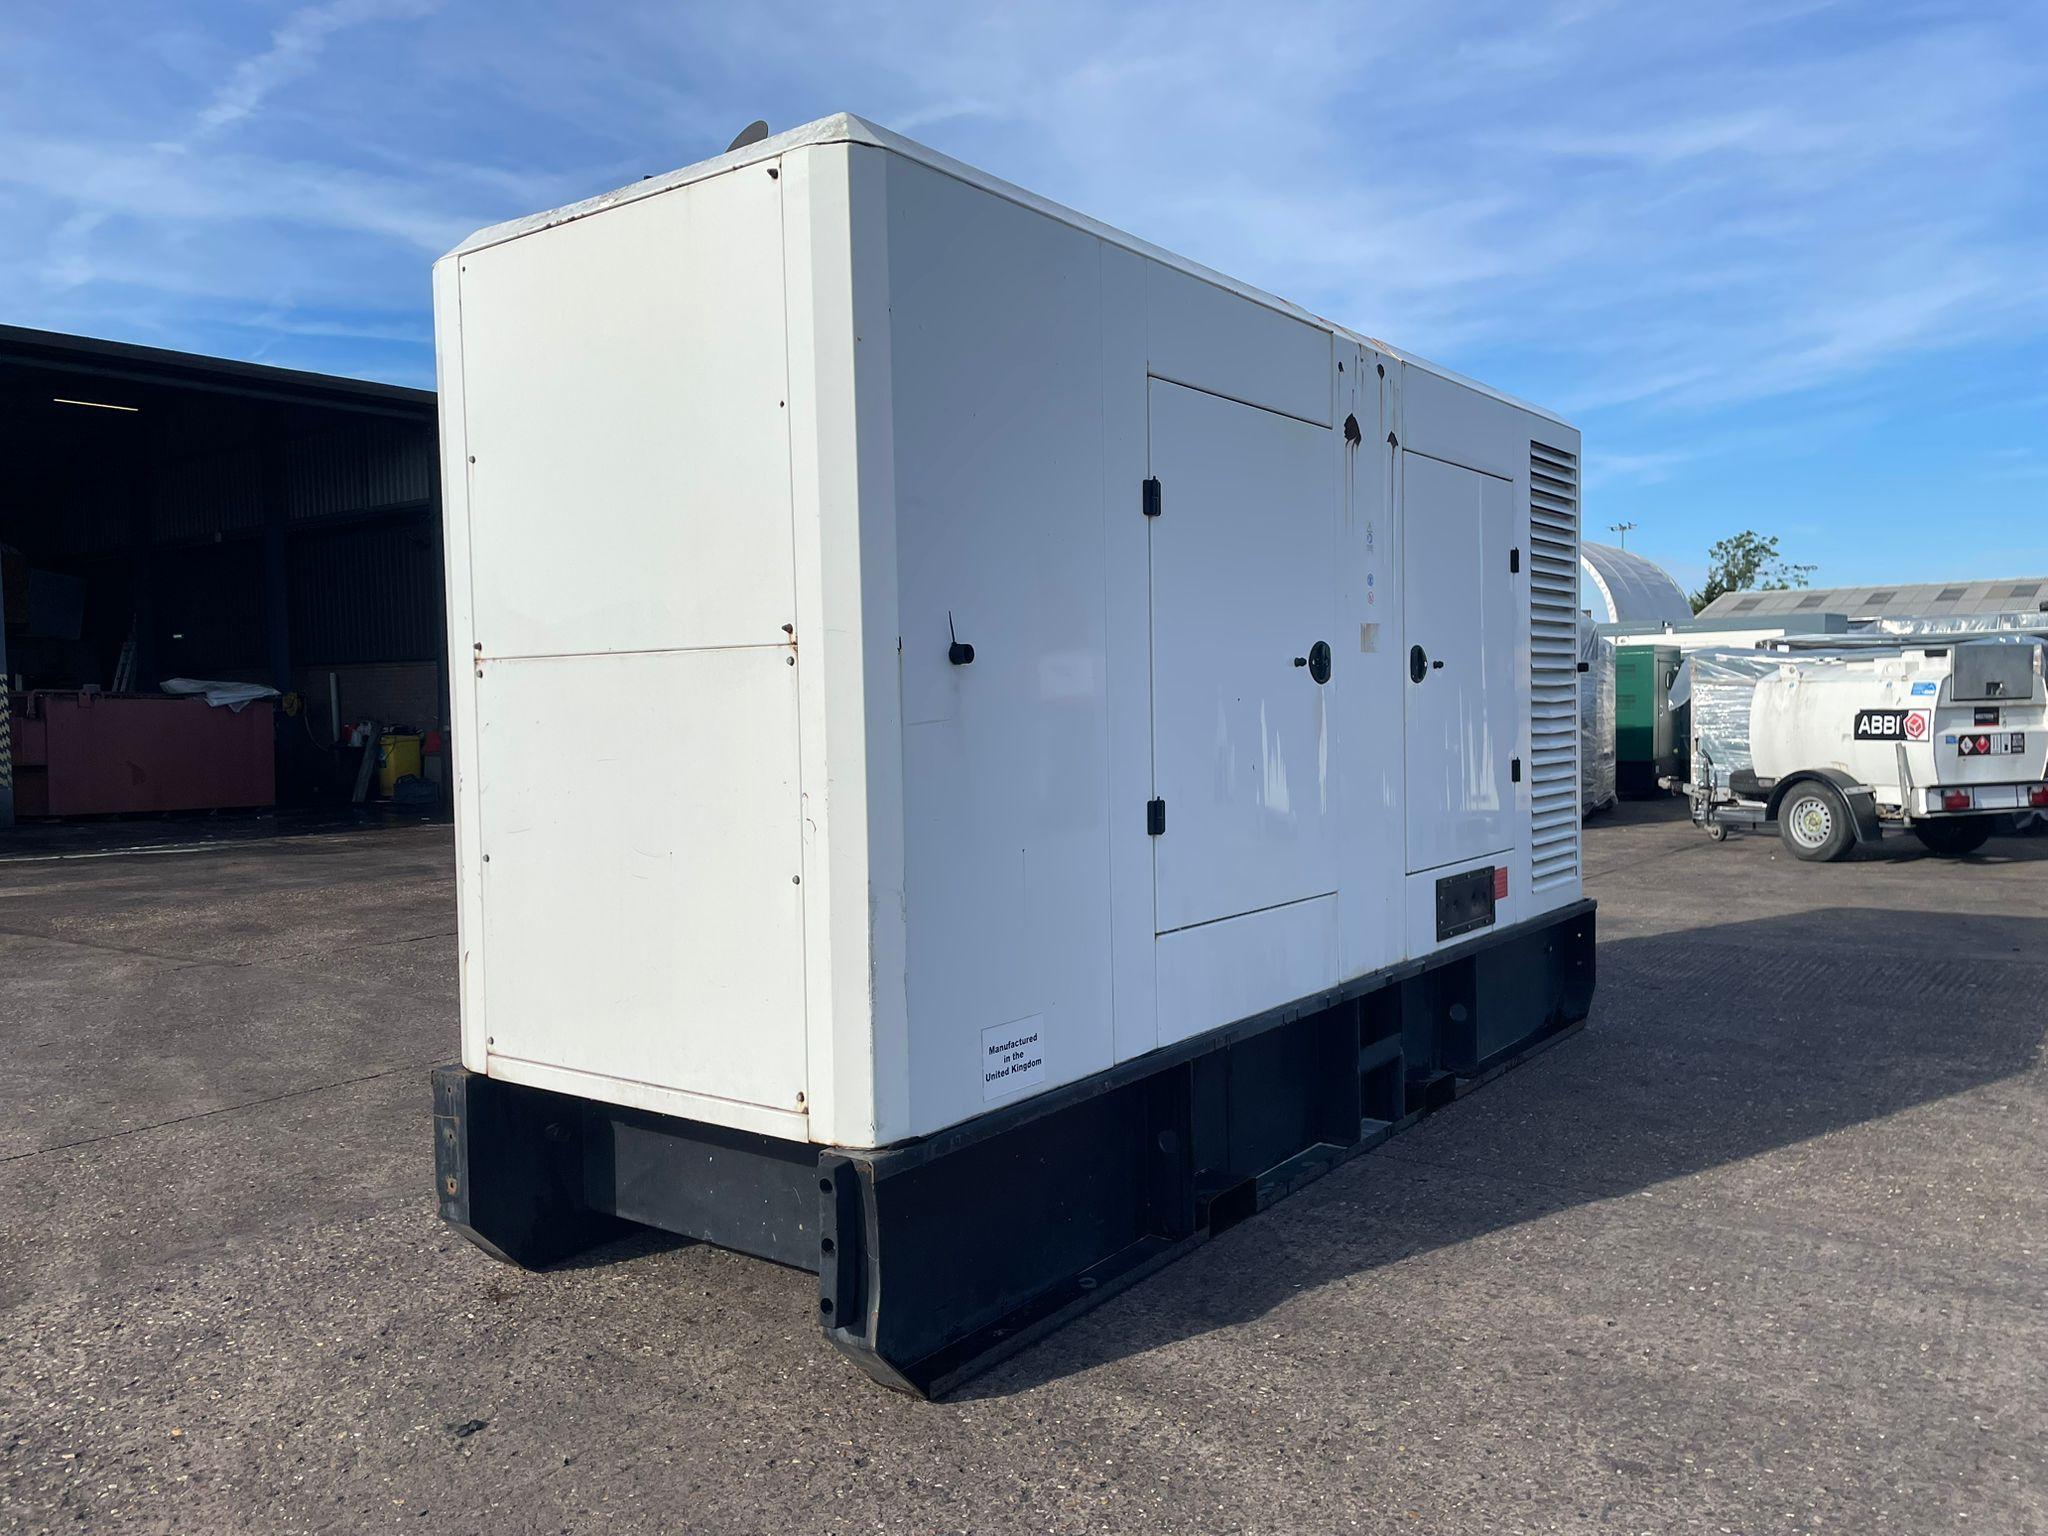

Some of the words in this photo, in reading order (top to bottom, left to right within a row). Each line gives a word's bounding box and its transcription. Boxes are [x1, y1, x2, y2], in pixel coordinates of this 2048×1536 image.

[1858, 715, 1900, 735] ABBI
[988, 1033, 1038, 1055] Manufactured
[1003, 1055, 1010, 1063] in
[1012, 1051, 1024, 1060] the
[985, 1067, 1010, 1082] United
[1011, 1058, 1042, 1074] Kingdom
